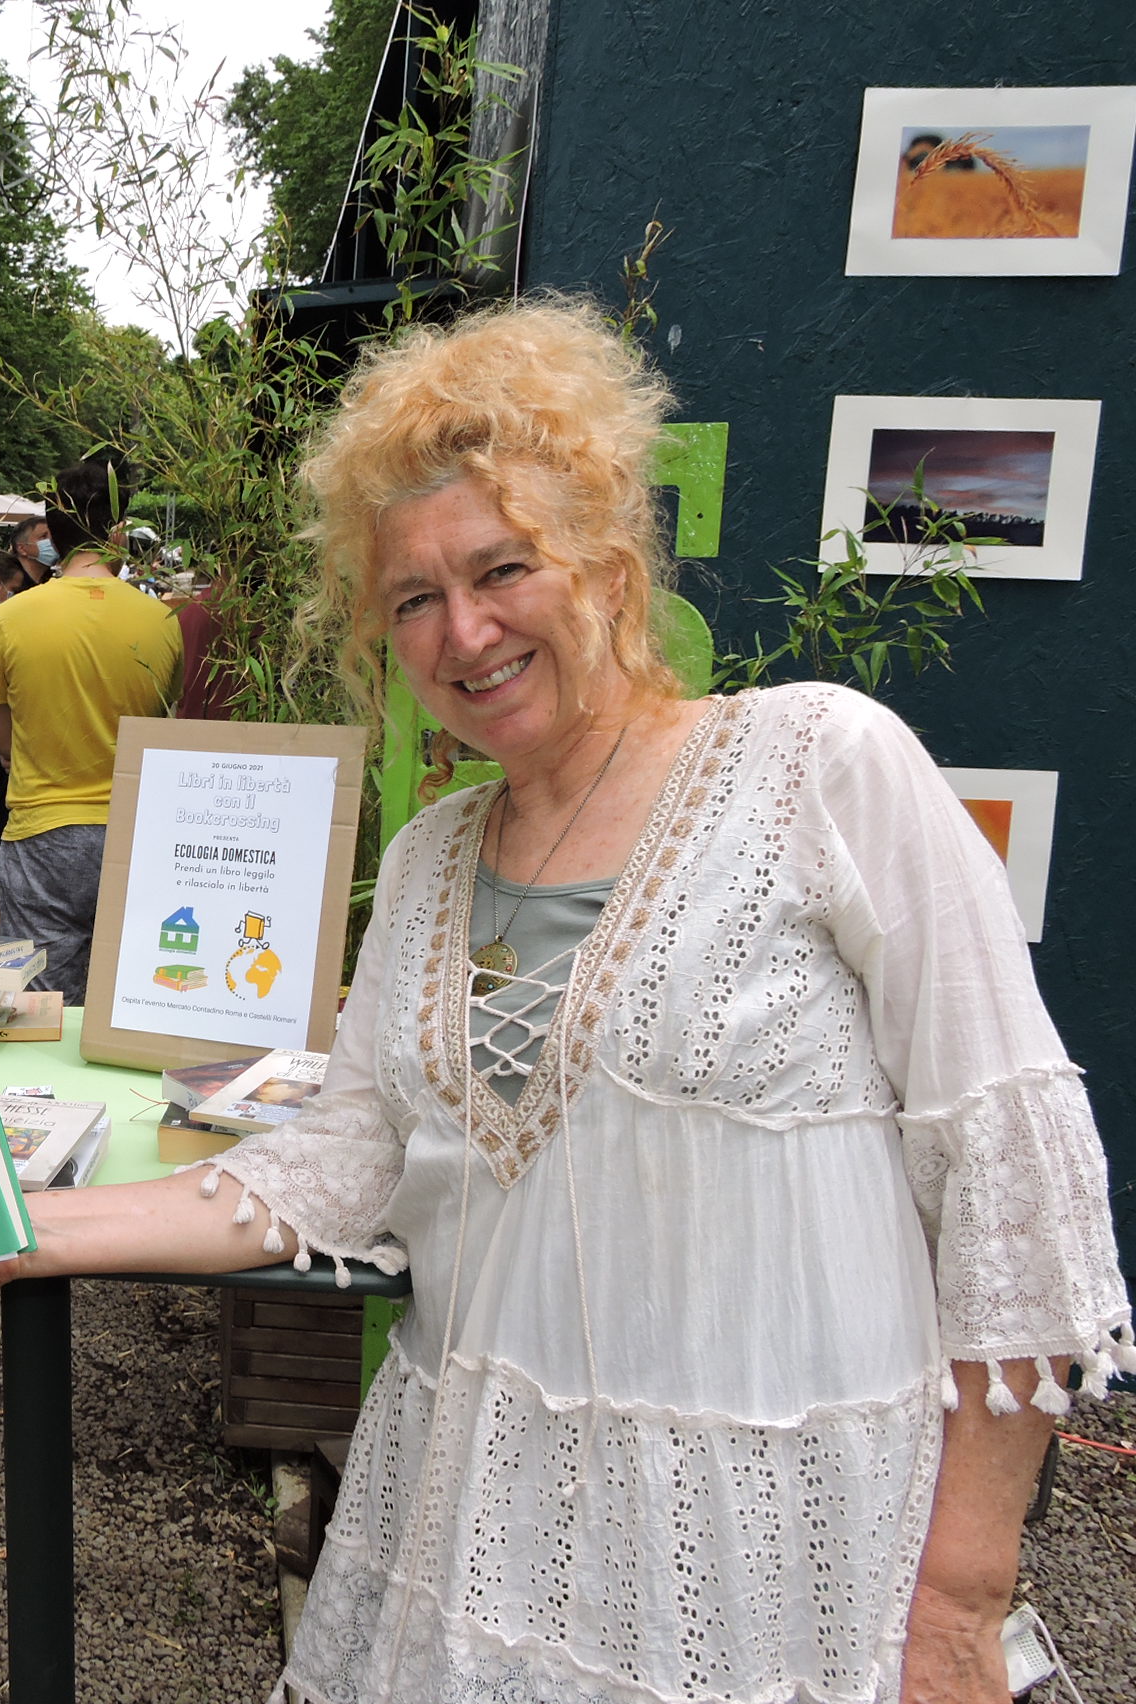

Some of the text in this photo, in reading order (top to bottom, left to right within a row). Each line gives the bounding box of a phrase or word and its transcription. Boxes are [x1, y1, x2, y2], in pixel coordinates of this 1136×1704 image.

[178, 772, 291, 793] Libri in libertà
[214, 793, 256, 809] con il
[176, 807, 280, 833] Bookcrossing
[174, 843, 276, 865] ECOLOGIA DOMESTICA
[174, 862, 203, 873] Prendi
[220, 865, 240, 876] libro
[244, 867, 275, 880] leggilo
[184, 878, 224, 890] rilascialo
[227, 882, 236, 890] in
[239, 882, 269, 893] libertà
[167, 1002, 191, 1011] Mercato
[192, 1005, 224, 1015] Contadino
[225, 1009, 243, 1017] Roma
[249, 1012, 272, 1021] Castelli
[273, 1015, 297, 1023] Romani
